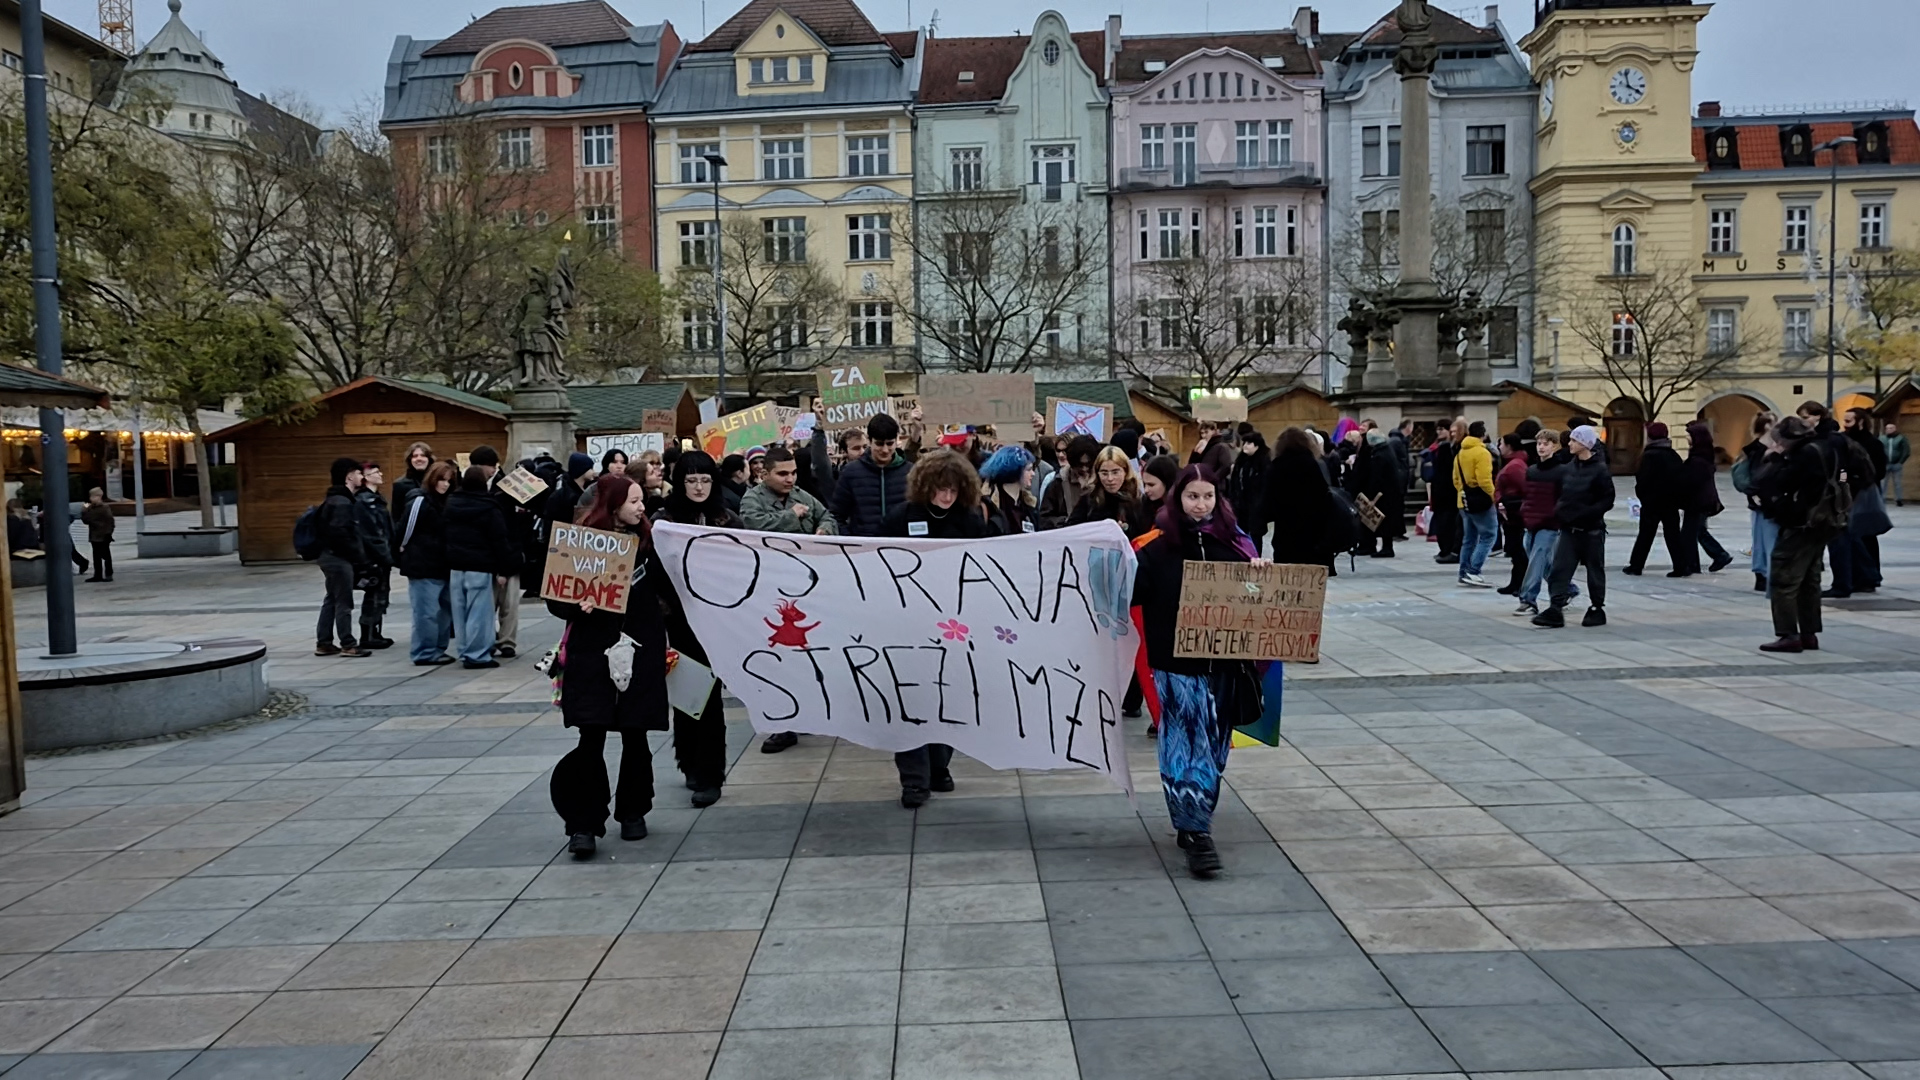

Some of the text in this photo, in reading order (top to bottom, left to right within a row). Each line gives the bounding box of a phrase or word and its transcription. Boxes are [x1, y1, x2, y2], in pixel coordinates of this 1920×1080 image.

[1702, 255, 1895, 274] MUSEUM
[831, 366, 866, 387] ZA
[721, 411, 748, 432] LET
[753, 405, 767, 423] IT
[826, 399, 888, 423] OSTRAVU
[555, 525, 632, 556] PŘÍRODU
[572, 555, 606, 575] VAM
[545, 572, 625, 610] NEDÁME
[1242, 609, 1256, 629] A
[1007, 658, 1116, 773] MŽP
